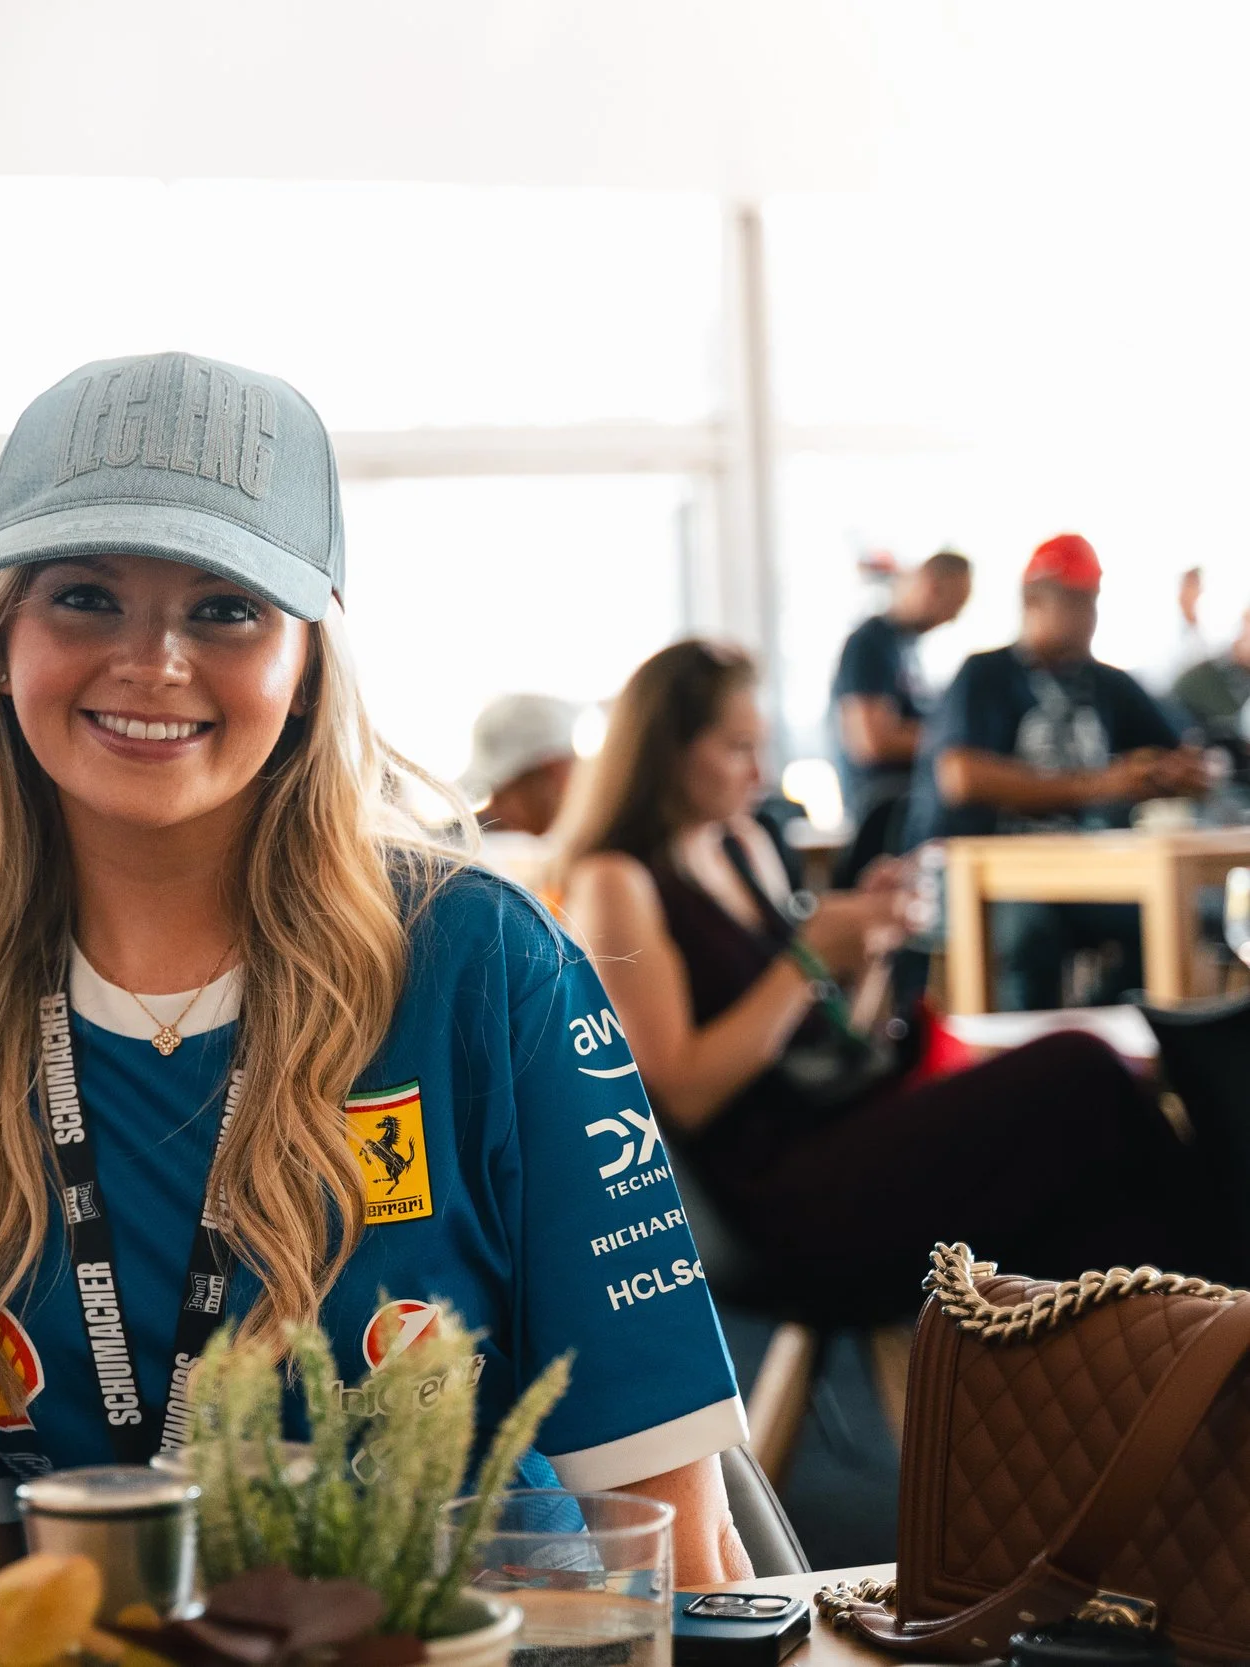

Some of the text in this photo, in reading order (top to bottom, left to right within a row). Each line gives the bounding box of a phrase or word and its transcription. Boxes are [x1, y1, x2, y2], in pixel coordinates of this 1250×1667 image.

[54, 356, 276, 501] LECLERC
[569, 1008, 626, 1056] aw
[585, 1108, 663, 1180] DX
[78, 1183, 97, 1220] LOUNGE
[366, 1194, 425, 1217] errari
[590, 1207, 688, 1257] RICHAR
[188, 1275, 209, 1311] LOUNGE
[206, 1276, 224, 1312] DRIVER
[76, 1261, 143, 1426] SCHUMACHER
